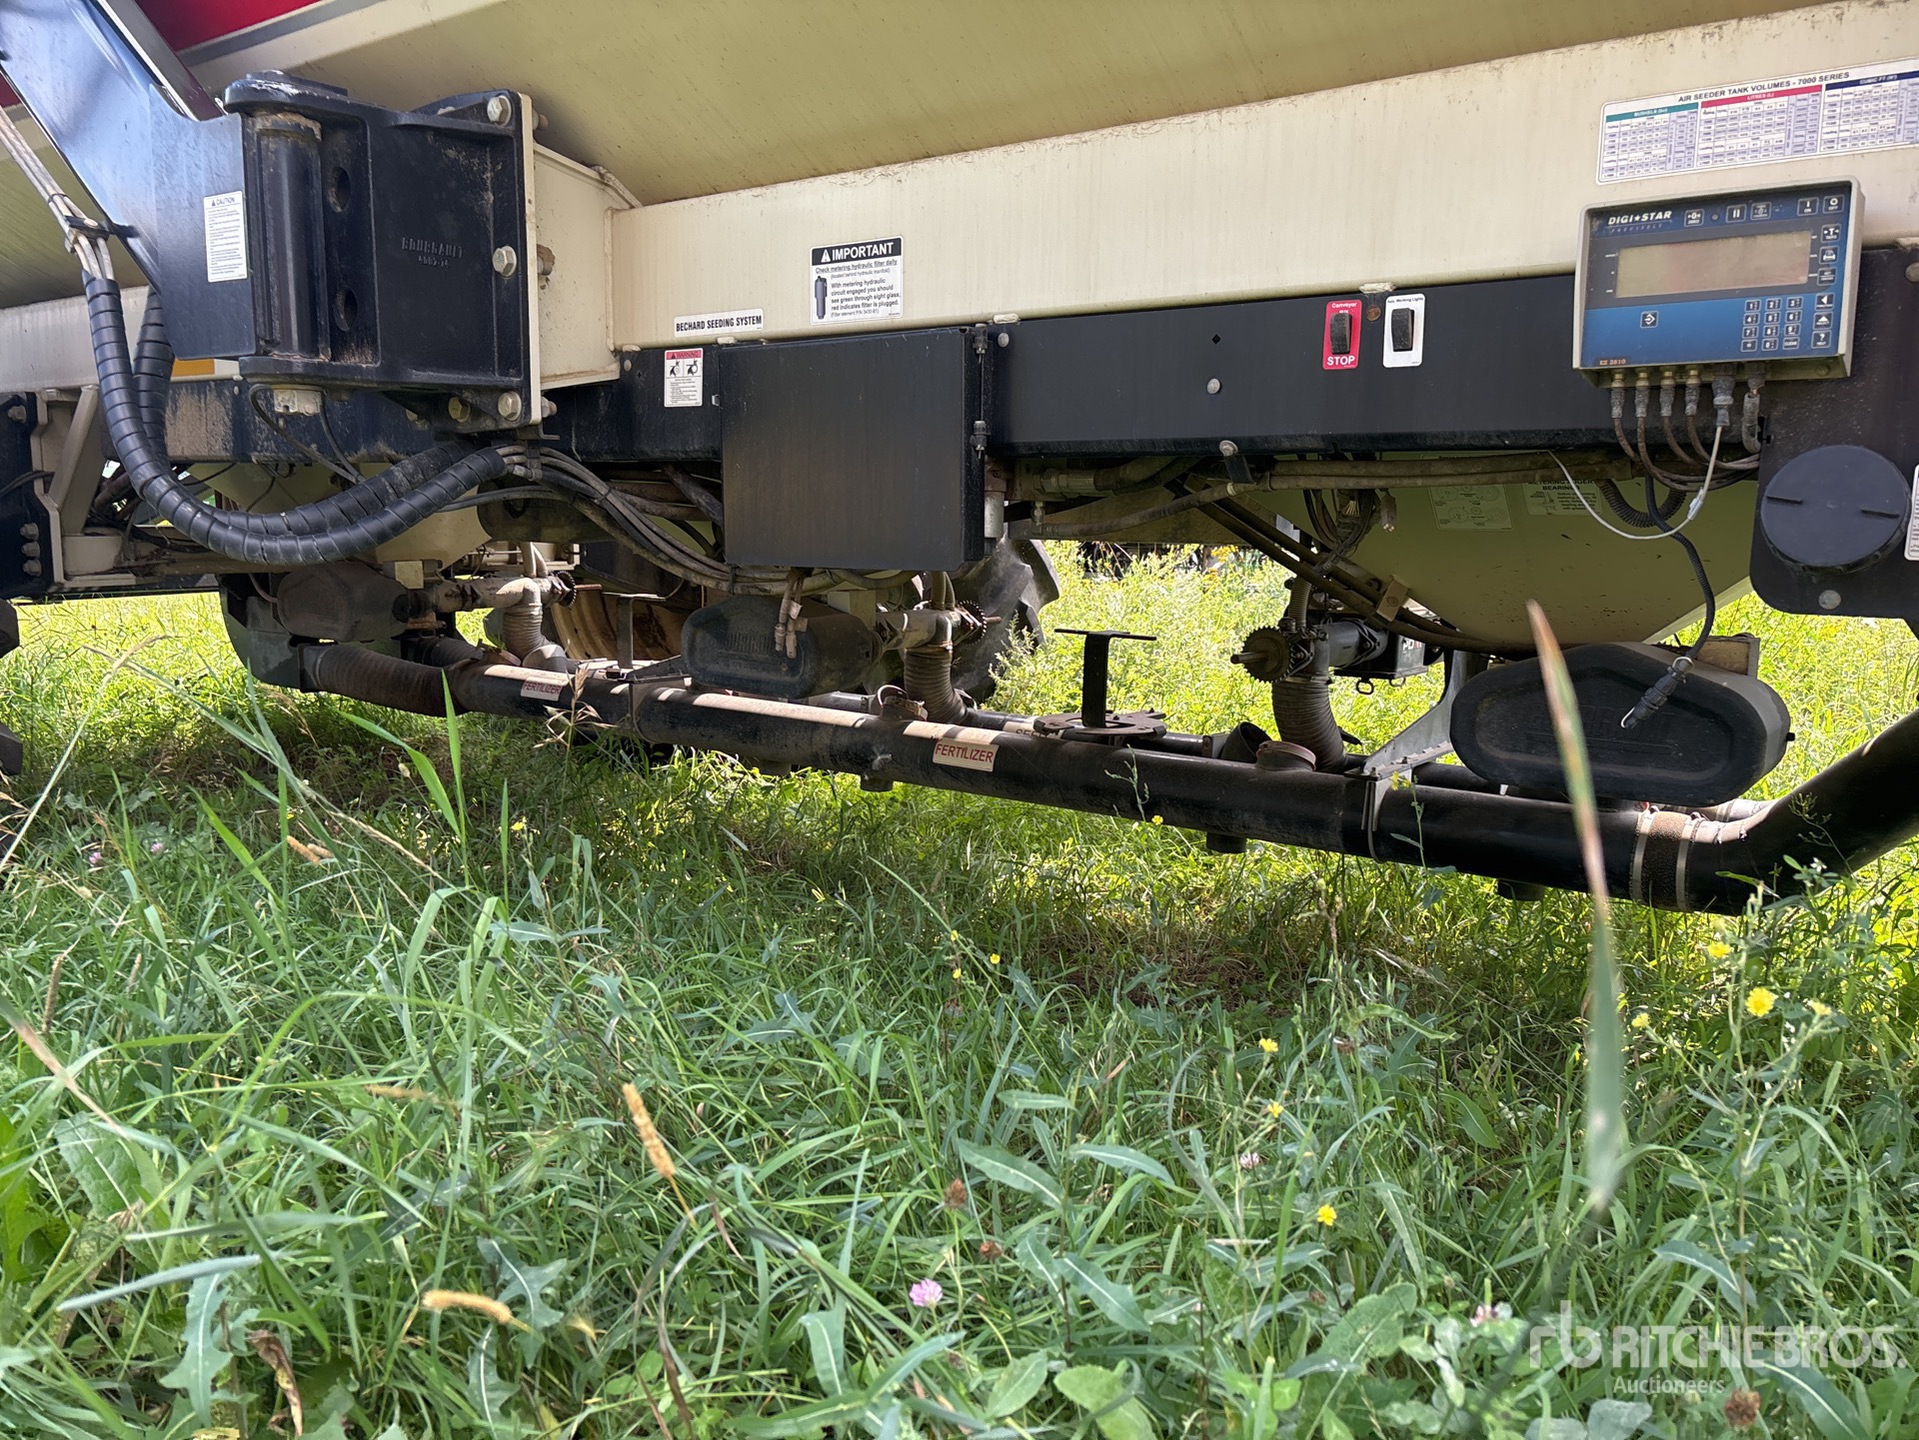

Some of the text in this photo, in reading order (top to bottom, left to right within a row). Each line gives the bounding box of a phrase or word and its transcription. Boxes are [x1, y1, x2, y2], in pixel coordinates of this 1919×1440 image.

[1693, 90, 1726, 100] SEEDER
[1728, 86, 1748, 95] TANK
[1751, 81, 1790, 92] VOLUMES
[1798, 76, 1816, 85] 7000
[1818, 72, 1850, 83] SERIES
[216, 197, 235, 205] CAUTION
[832, 242, 894, 261] IMPORTANT
[852, 262, 873, 270] hydraulic
[864, 278, 886, 286] hydraulic
[847, 287, 866, 295] engaged
[854, 294, 873, 302] through
[676, 315, 762, 332] BECHARD SEEDING SYSTEM
[676, 351, 699, 359] WARNING
[1327, 355, 1355, 366] STOP
[524, 682, 562, 694] FERTILIZER
[935, 743, 994, 763] FERTILIZER
